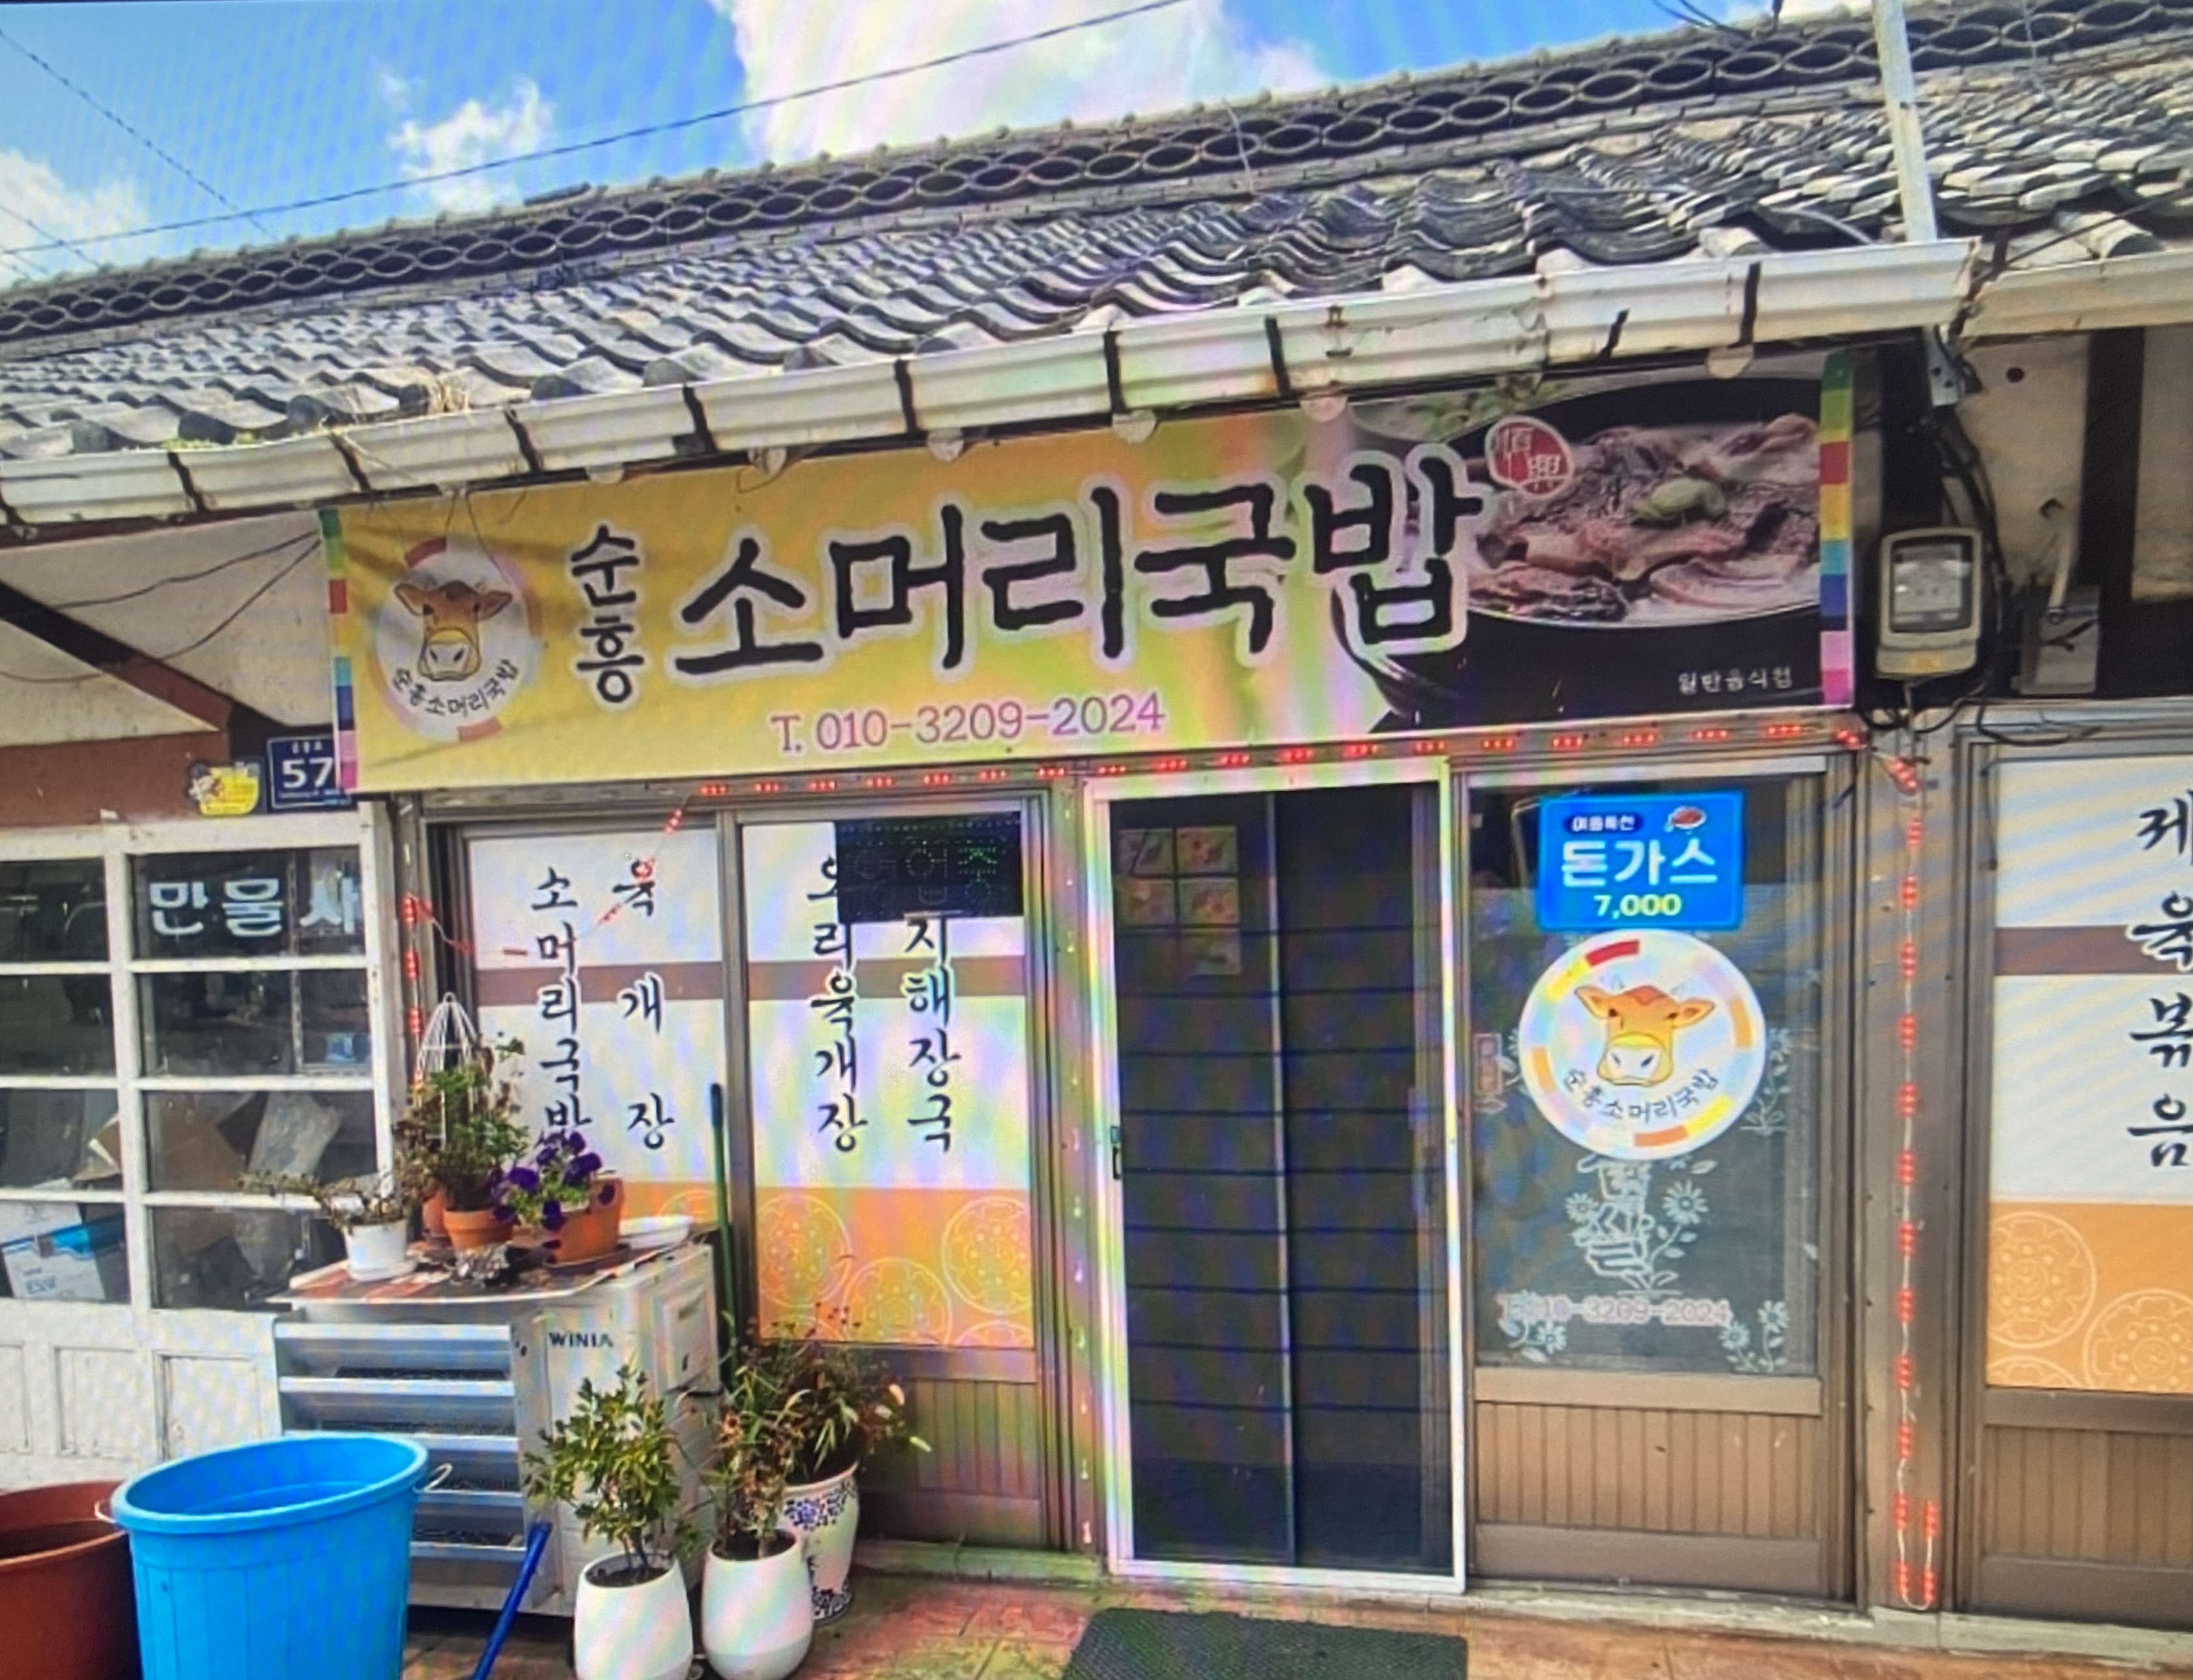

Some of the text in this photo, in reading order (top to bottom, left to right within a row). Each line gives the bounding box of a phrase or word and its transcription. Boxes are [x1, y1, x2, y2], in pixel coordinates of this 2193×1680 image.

[674, 456, 1485, 675] 소머리국밥
[569, 524, 645, 705] 순흥
[815, 692, 1166, 750] 010-3209-2024
[282, 757, 333, 789] 57
[1561, 837, 1718, 888] 돈가스
[1593, 893, 1682, 919] 7,000
[612, 858, 675, 1150] 육개장
[904, 915, 961, 1153] 지해장국
[548, 1331, 614, 1348] WINIA
